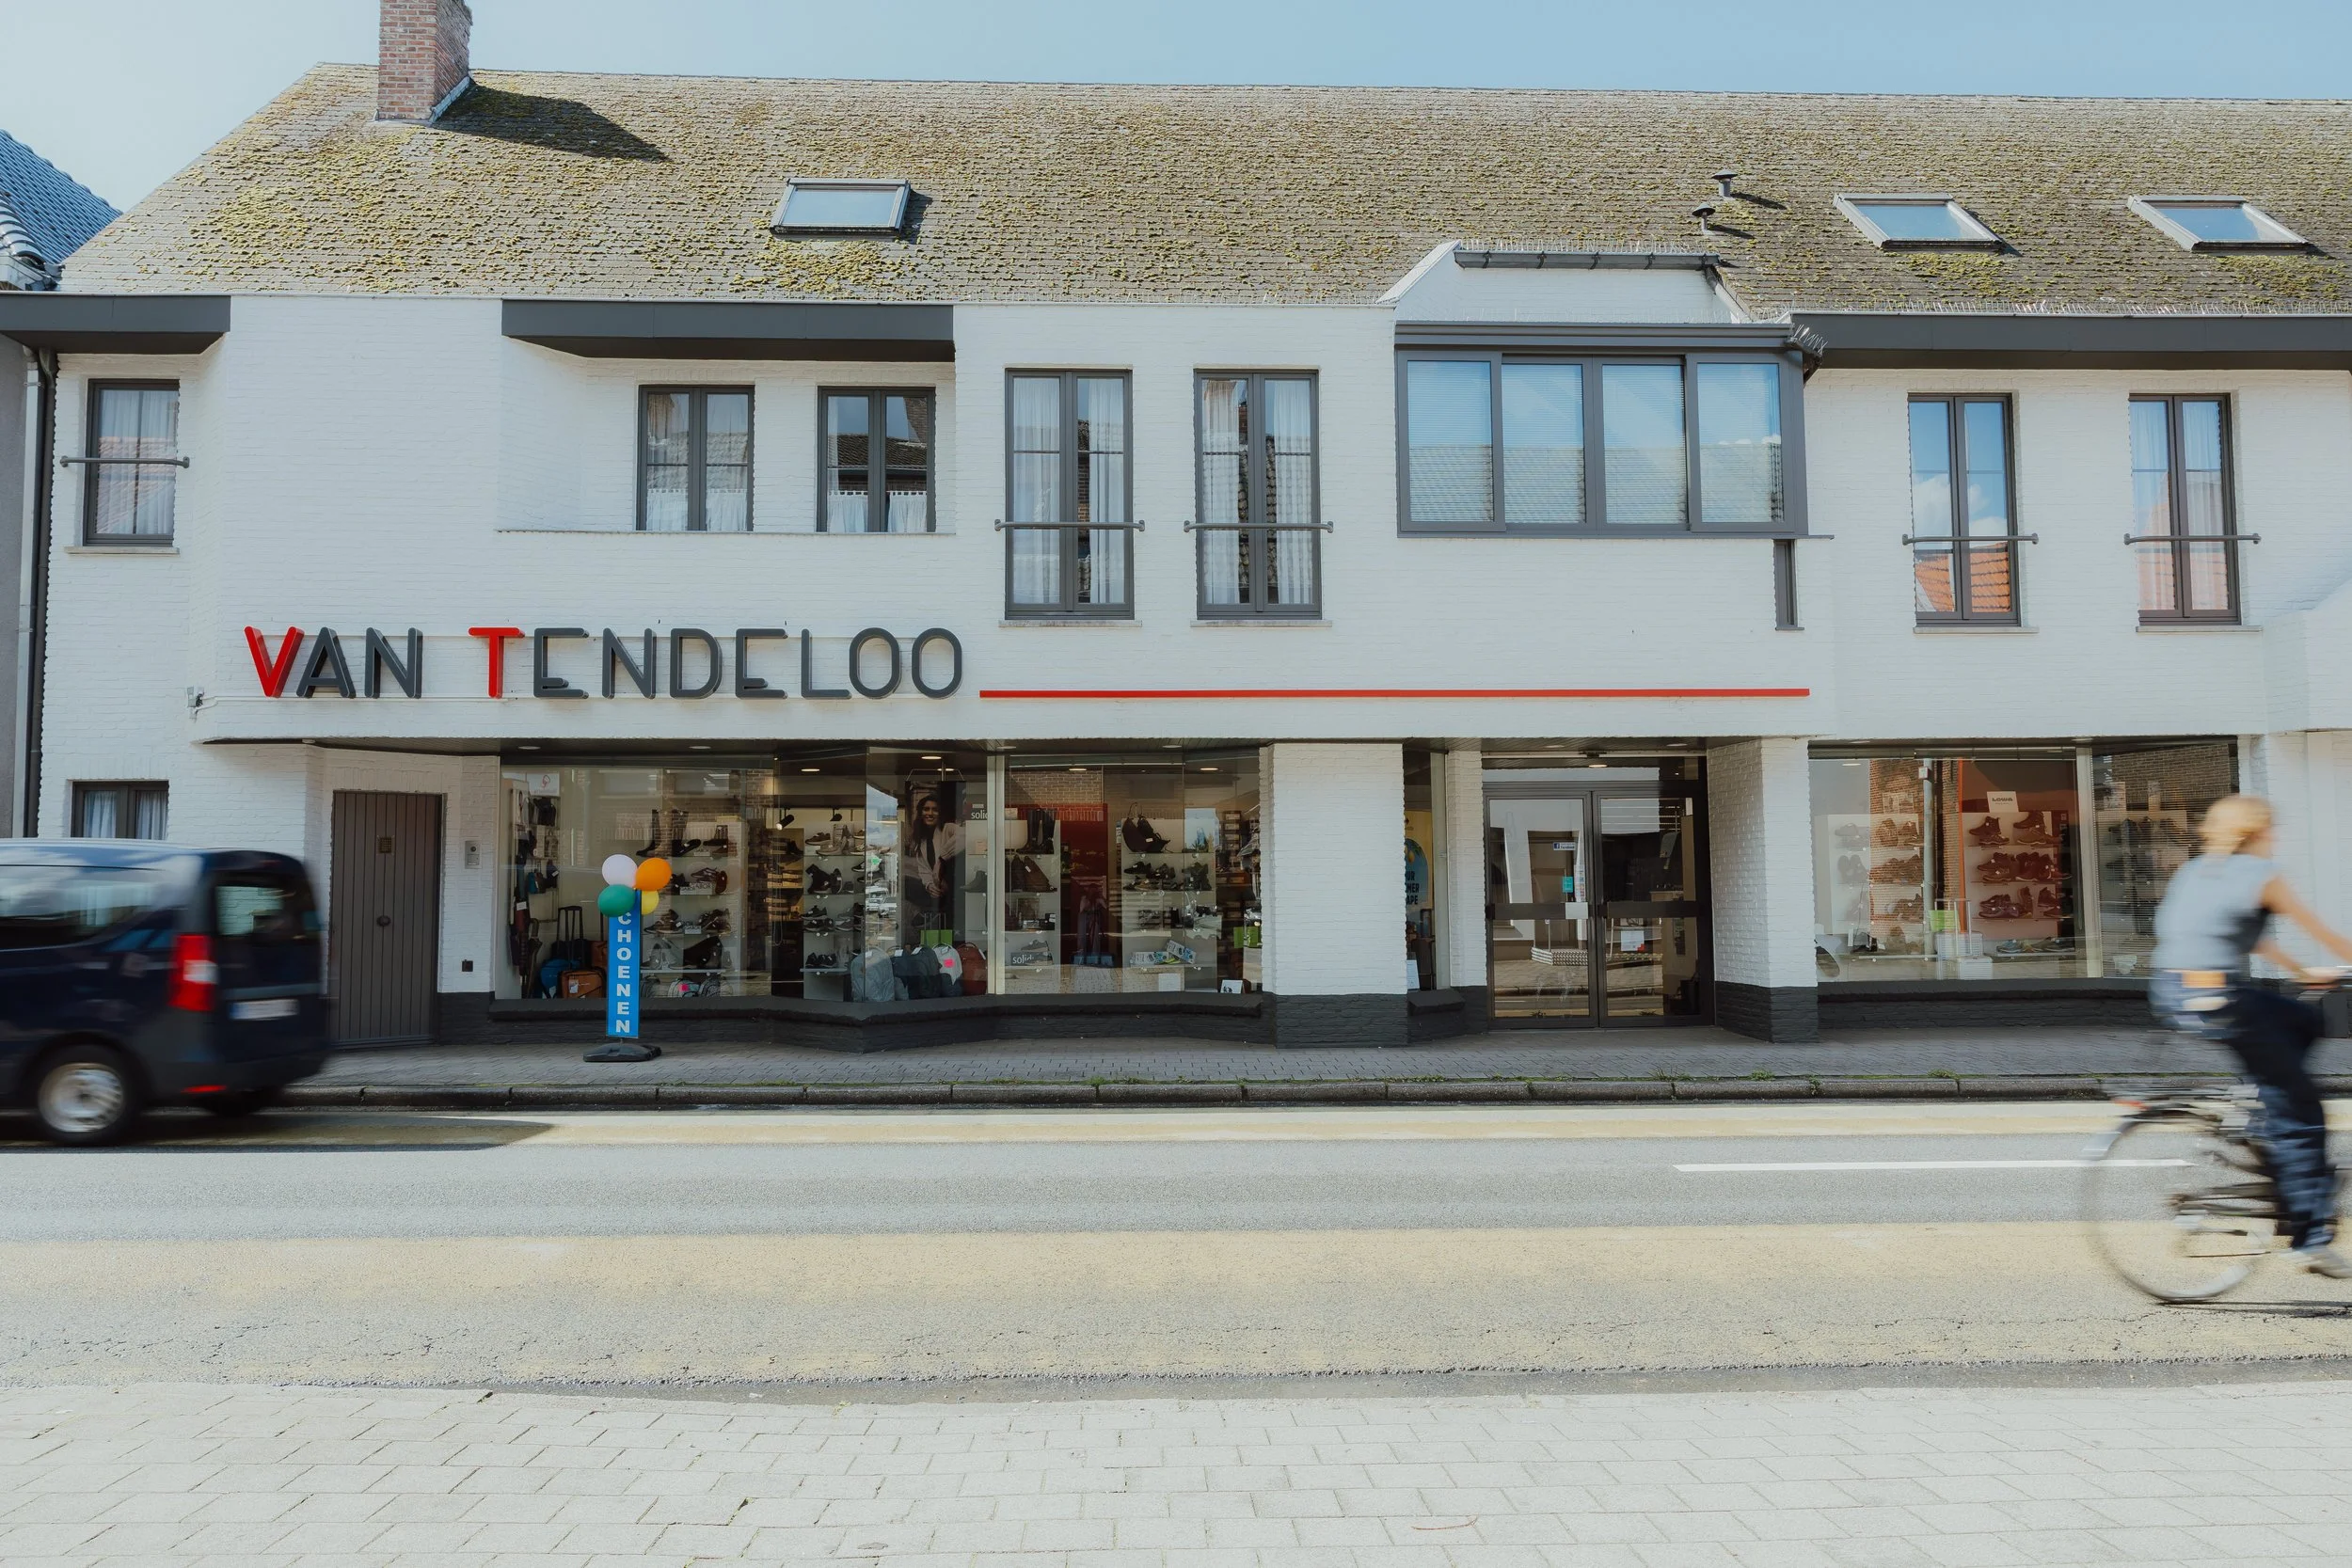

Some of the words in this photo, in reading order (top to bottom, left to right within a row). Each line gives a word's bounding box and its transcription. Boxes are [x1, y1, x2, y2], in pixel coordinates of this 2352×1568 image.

[244, 626, 423, 699] VAN
[468, 626, 962, 699] TENDELOO
[1406, 895, 1419, 905] APE
[615, 911, 632, 1034] CHOENEN
[1012, 954, 1034, 964] solid
